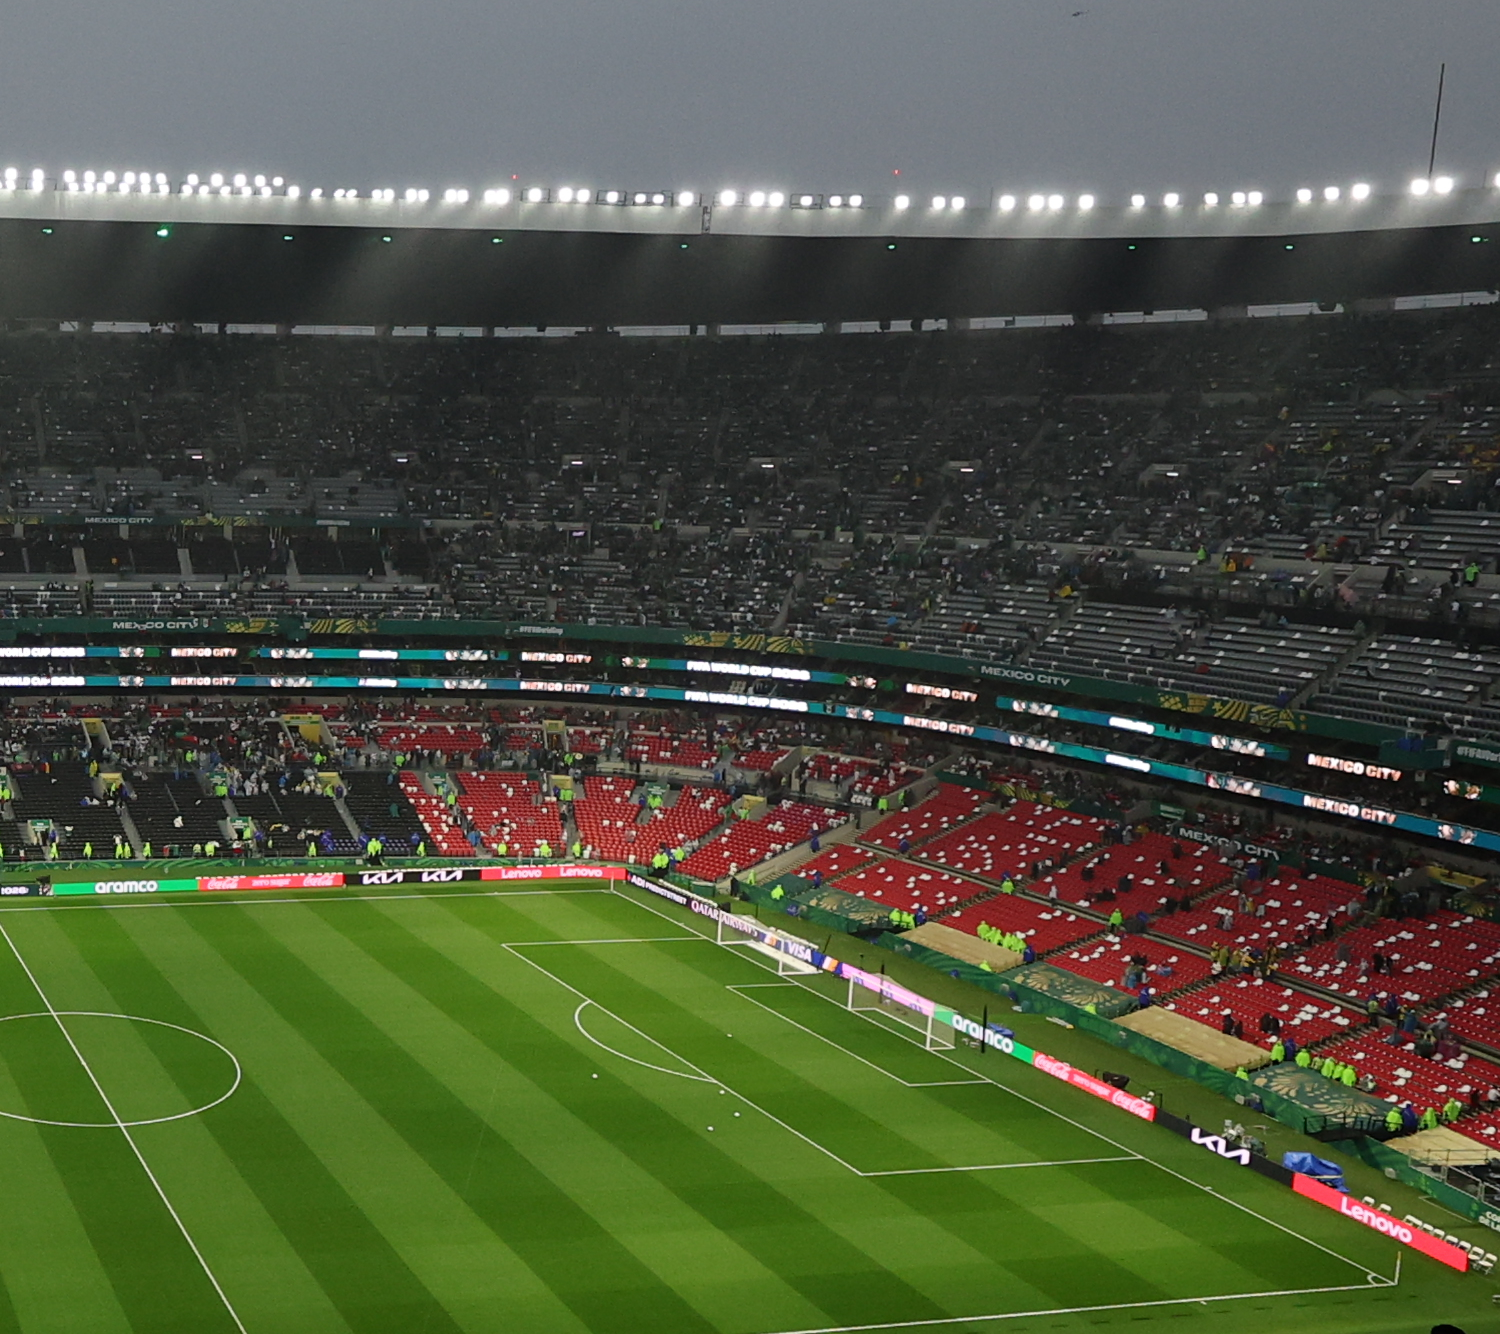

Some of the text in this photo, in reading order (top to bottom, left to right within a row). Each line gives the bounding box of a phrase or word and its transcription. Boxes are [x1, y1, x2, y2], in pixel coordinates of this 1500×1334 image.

[112, 621, 165, 630] MEXCO
[981, 665, 1070, 686] MEXICO CITY
[906, 683, 977, 702] MEXICO CITY
[903, 716, 974, 735] MEXICO CITY
[1307, 753, 1401, 781] MEXICO CITY
[1303, 795, 1396, 824] MEXICO CITY
[362, 870, 463, 885] KIA KIA
[501, 867, 602, 879] Lenovo Lenovo
[95, 881, 158, 894] aramco
[691, 900, 719, 920] QATAR
[787, 941, 812, 962] VISA
[952, 1014, 1014, 1054] aramco
[1191, 1127, 1250, 1165] KIA
[1340, 1196, 1413, 1243] Lenovo
